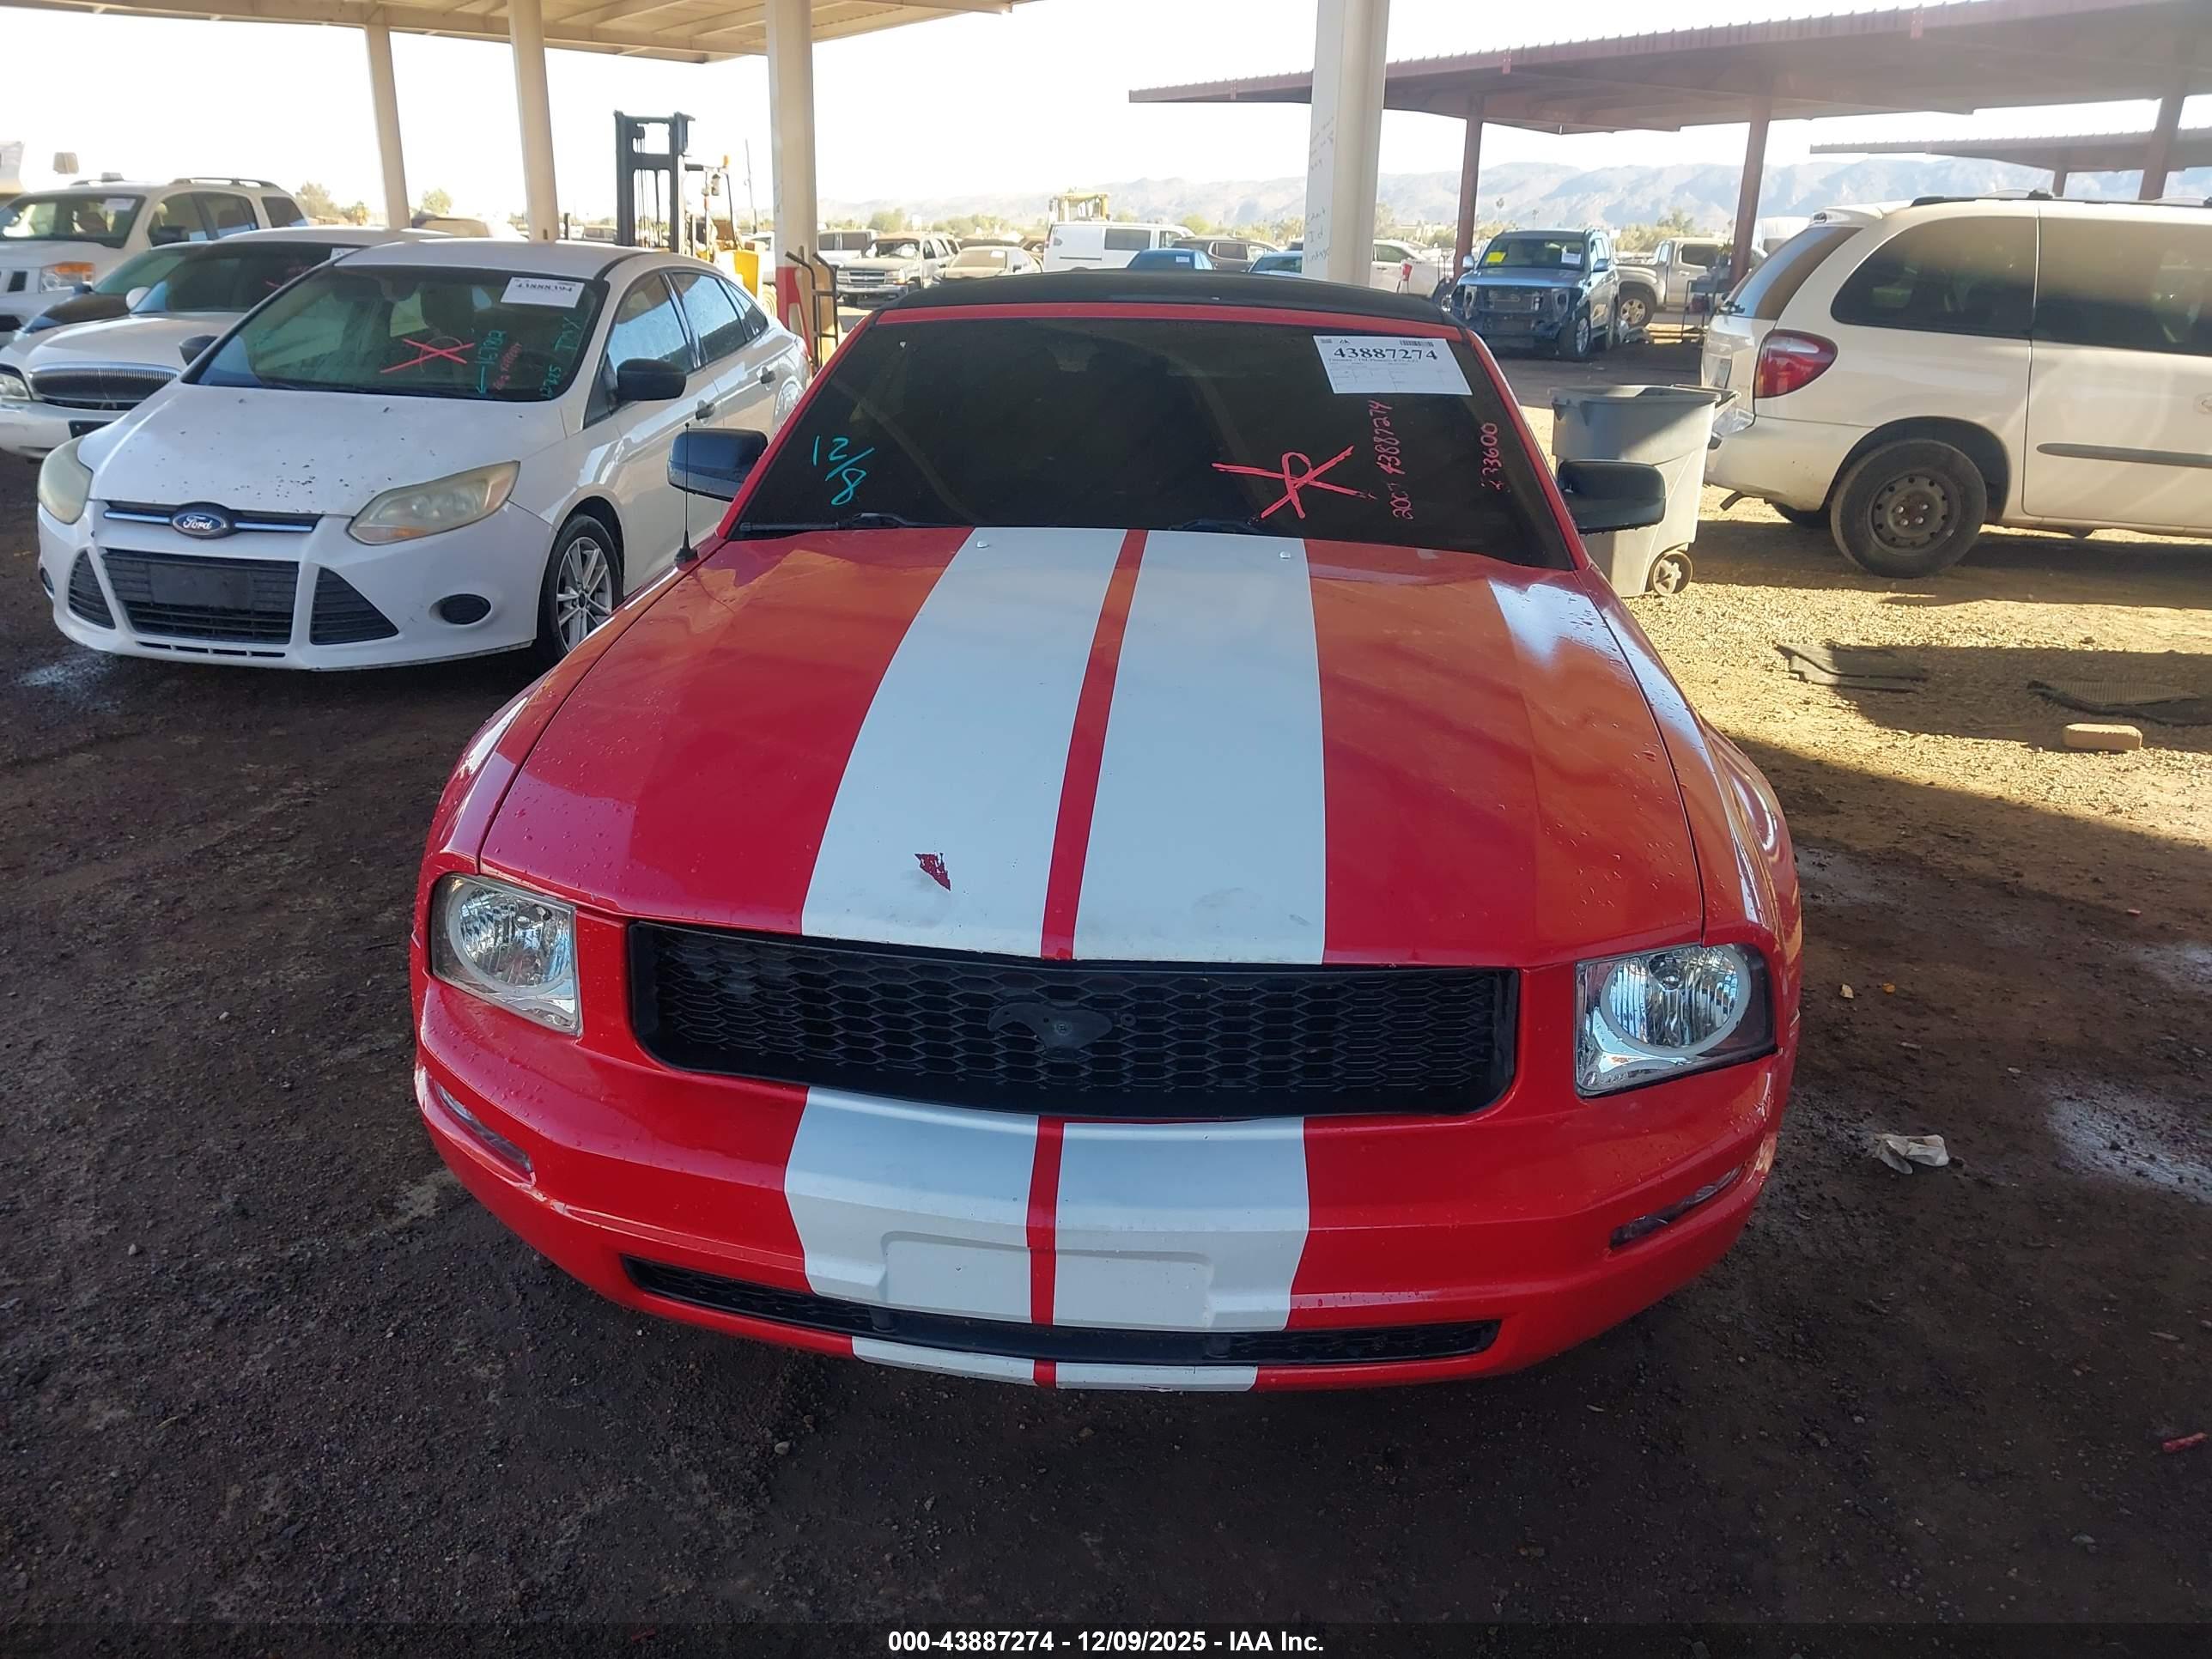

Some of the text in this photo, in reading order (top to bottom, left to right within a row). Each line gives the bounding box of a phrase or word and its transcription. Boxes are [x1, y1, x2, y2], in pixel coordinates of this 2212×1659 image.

[1334, 347, 1437, 361] 43887274
[1368, 399, 1406, 475] 43887274
[183, 515, 212, 530] Ford
